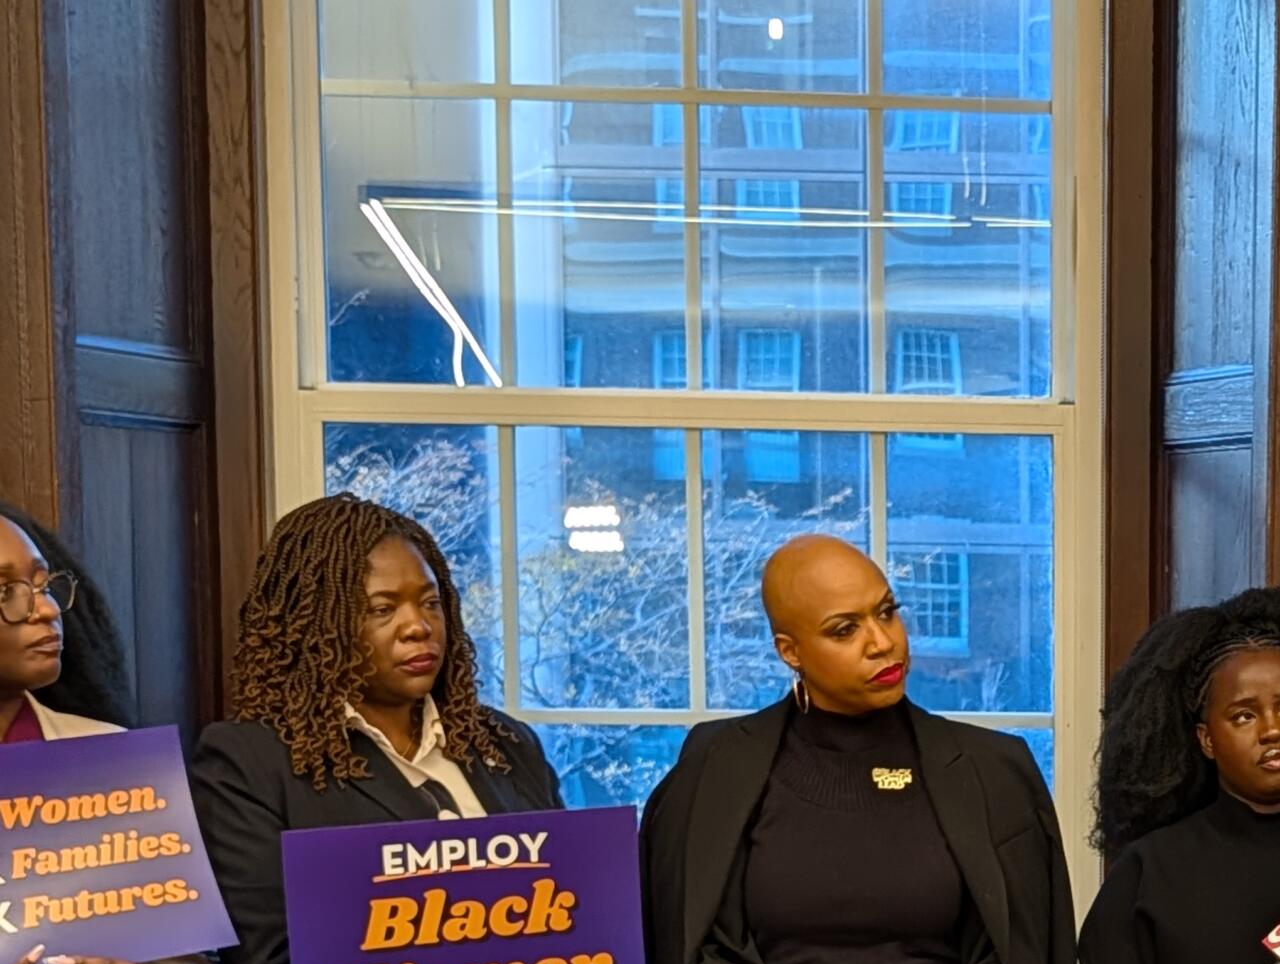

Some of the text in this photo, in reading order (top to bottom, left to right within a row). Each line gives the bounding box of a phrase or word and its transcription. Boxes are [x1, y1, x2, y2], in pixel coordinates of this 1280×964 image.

[0, 786, 167, 829] Women.
[11, 830, 191, 880] Families.
[381, 832, 549, 876] EMPLOY
[23, 879, 199, 929] Futures.
[360, 878, 576, 951] Black
